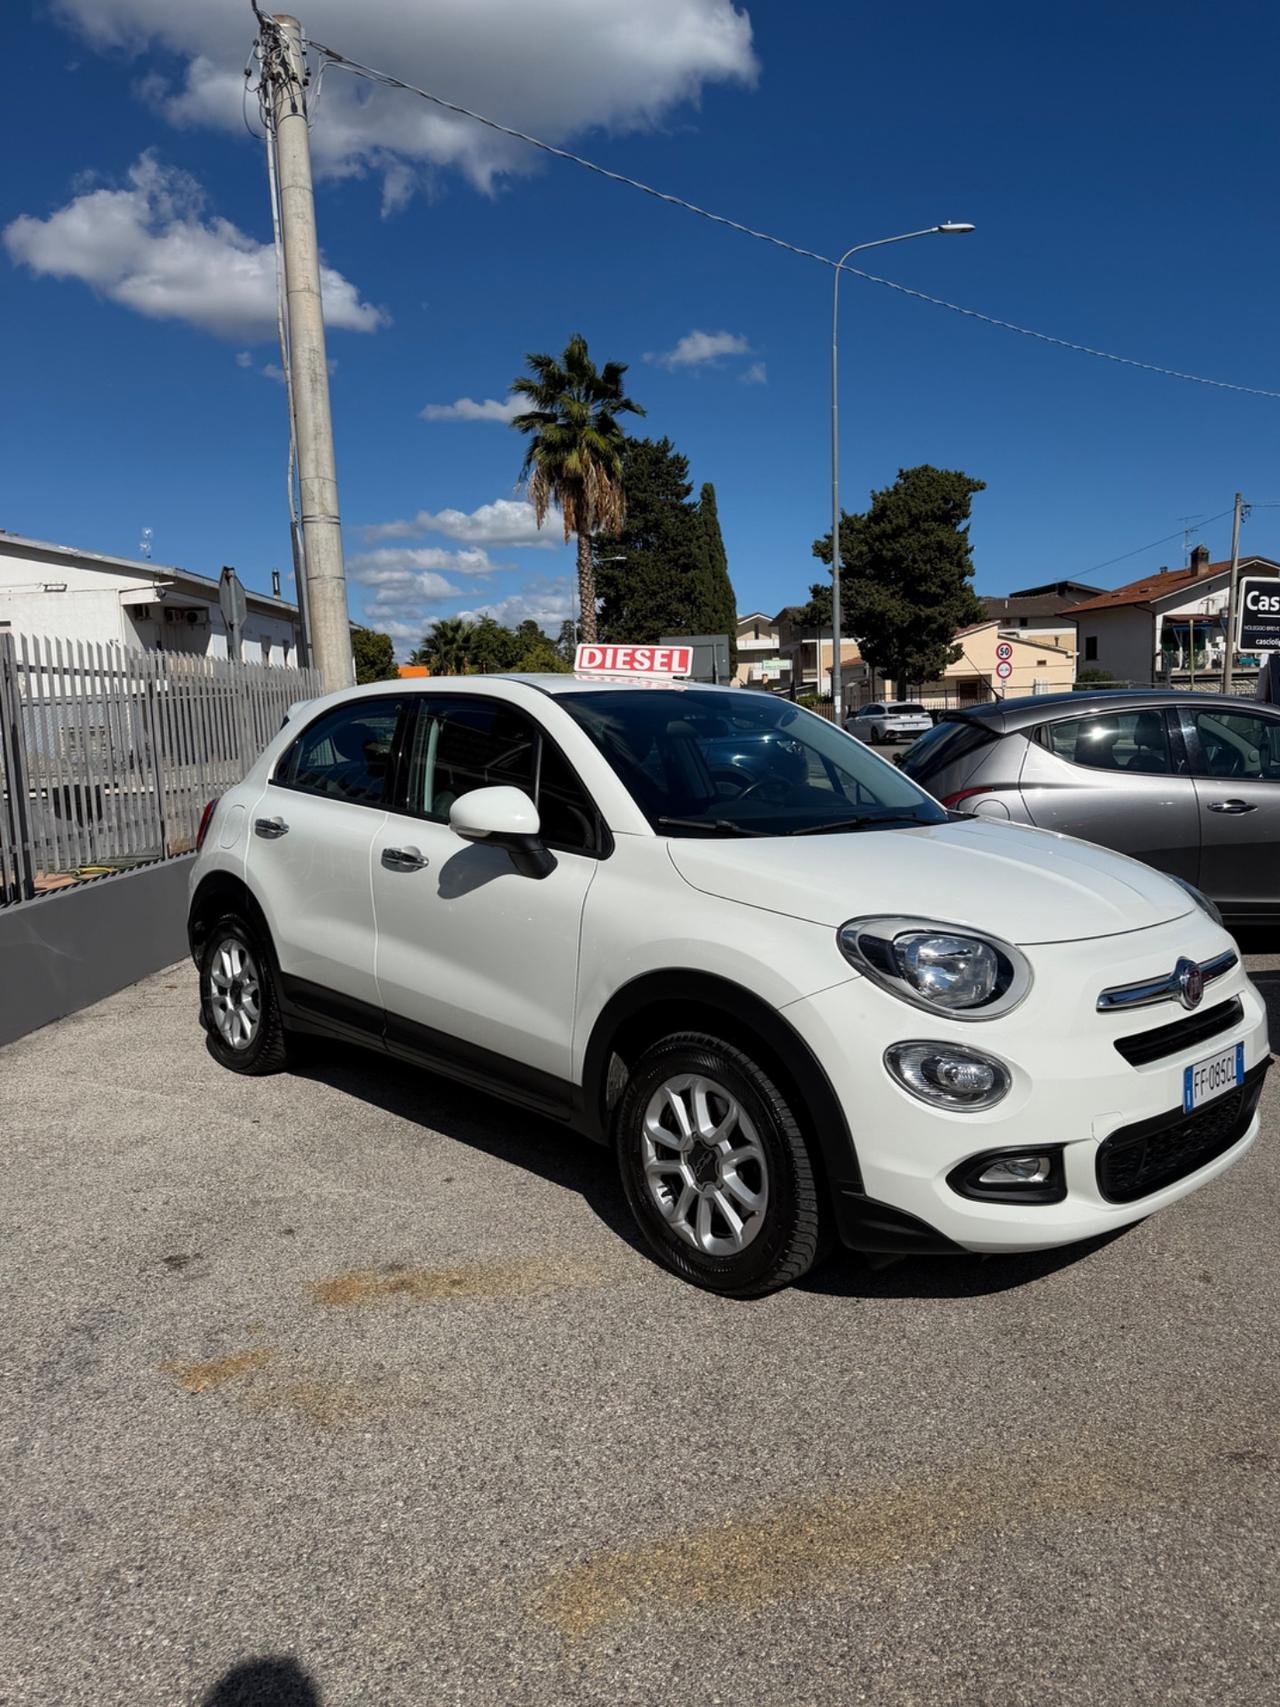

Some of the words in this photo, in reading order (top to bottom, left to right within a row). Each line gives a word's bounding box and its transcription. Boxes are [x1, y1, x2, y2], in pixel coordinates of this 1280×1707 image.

[1246, 590, 1280, 612] Cas
[580, 648, 686, 672] DIESEL
[999, 647, 1010, 656] 50
